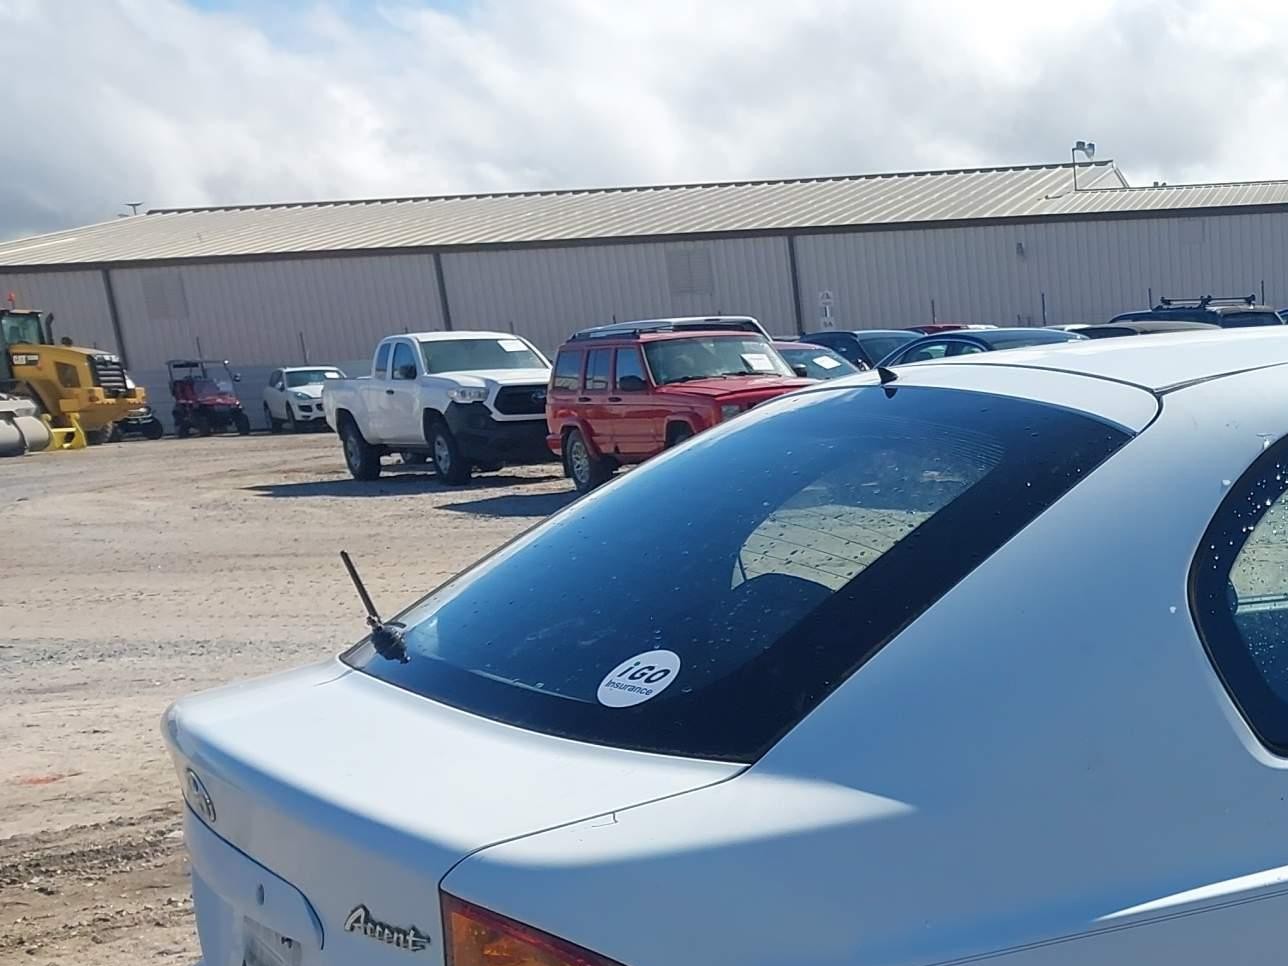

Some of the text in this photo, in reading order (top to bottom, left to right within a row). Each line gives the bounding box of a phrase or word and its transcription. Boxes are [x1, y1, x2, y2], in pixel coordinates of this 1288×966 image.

[617, 661, 671, 684] iGO
[605, 679, 654, 696] Insurance
[344, 904, 431, 952] Accent
